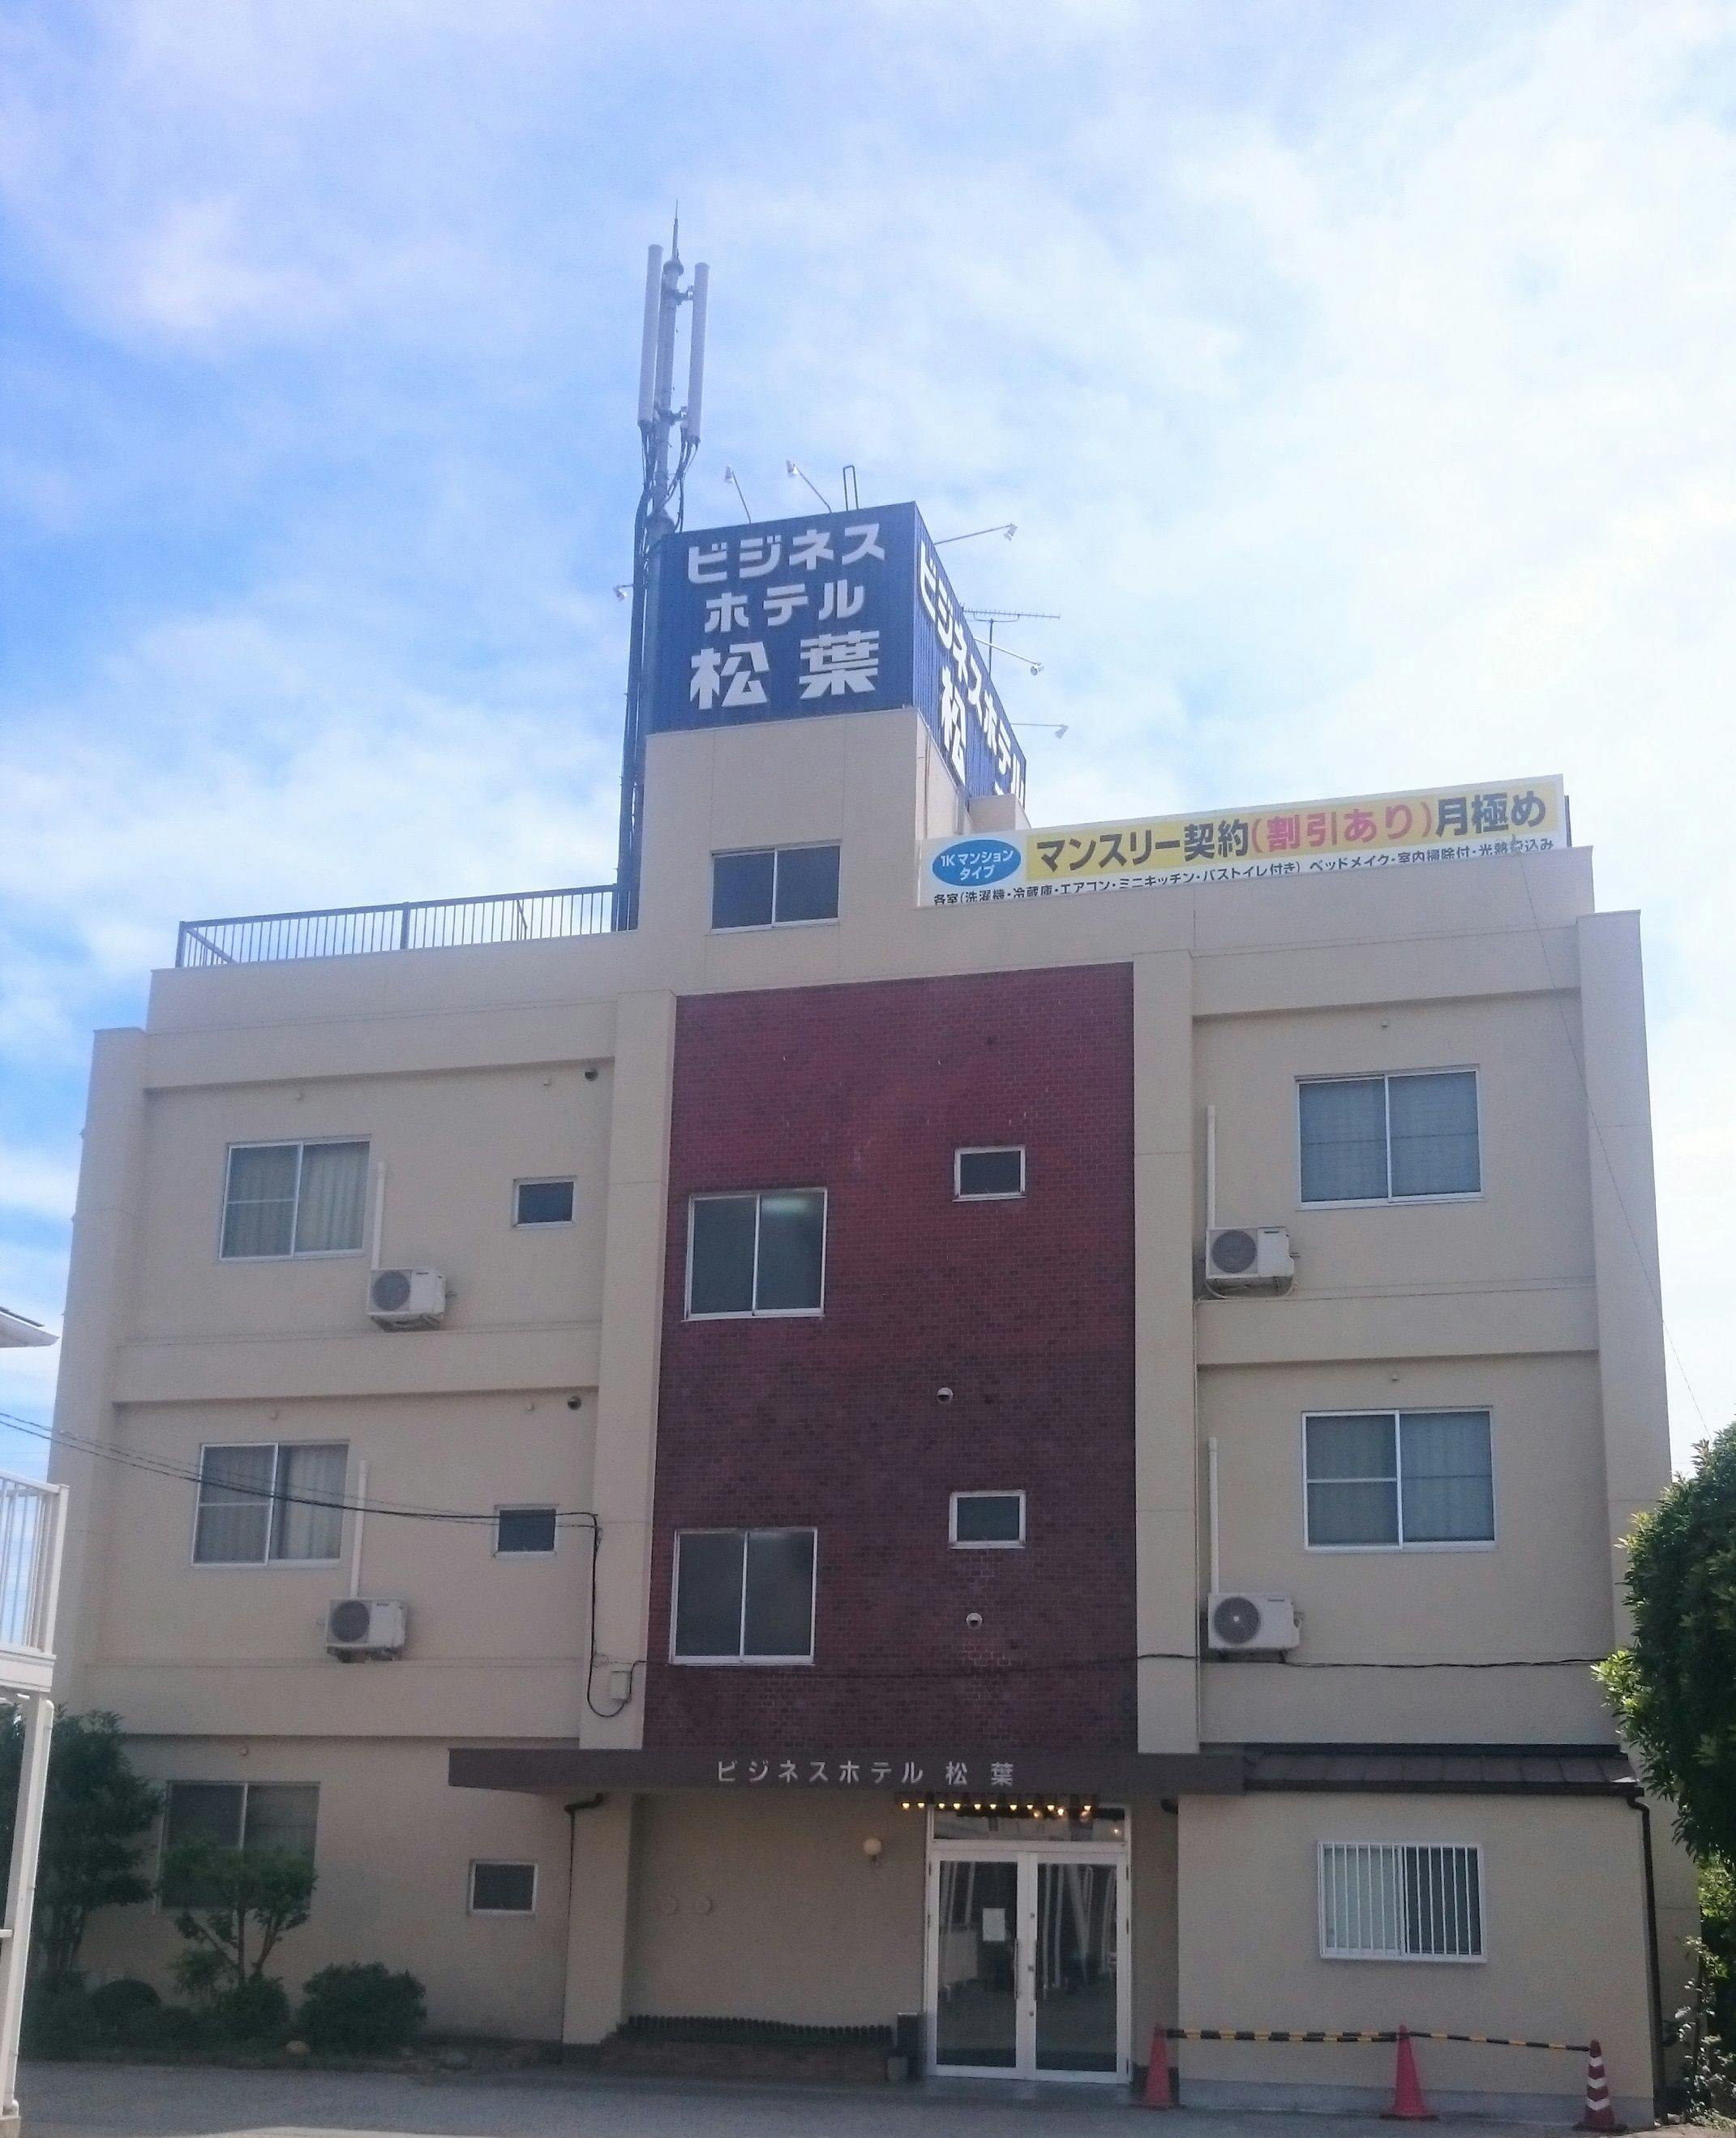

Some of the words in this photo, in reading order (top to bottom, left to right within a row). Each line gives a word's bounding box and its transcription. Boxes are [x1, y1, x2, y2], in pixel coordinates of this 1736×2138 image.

[688, 523, 886, 585] ビジネス
[704, 579, 865, 632] ホテル
[689, 630, 881, 710] 松葉
[921, 539, 1025, 806] ビジネスホテル
[959, 864, 996, 881] タイプ
[717, 1759, 924, 1784] ビジネスホテル
[945, 1761, 1014, 1785] 松葉
